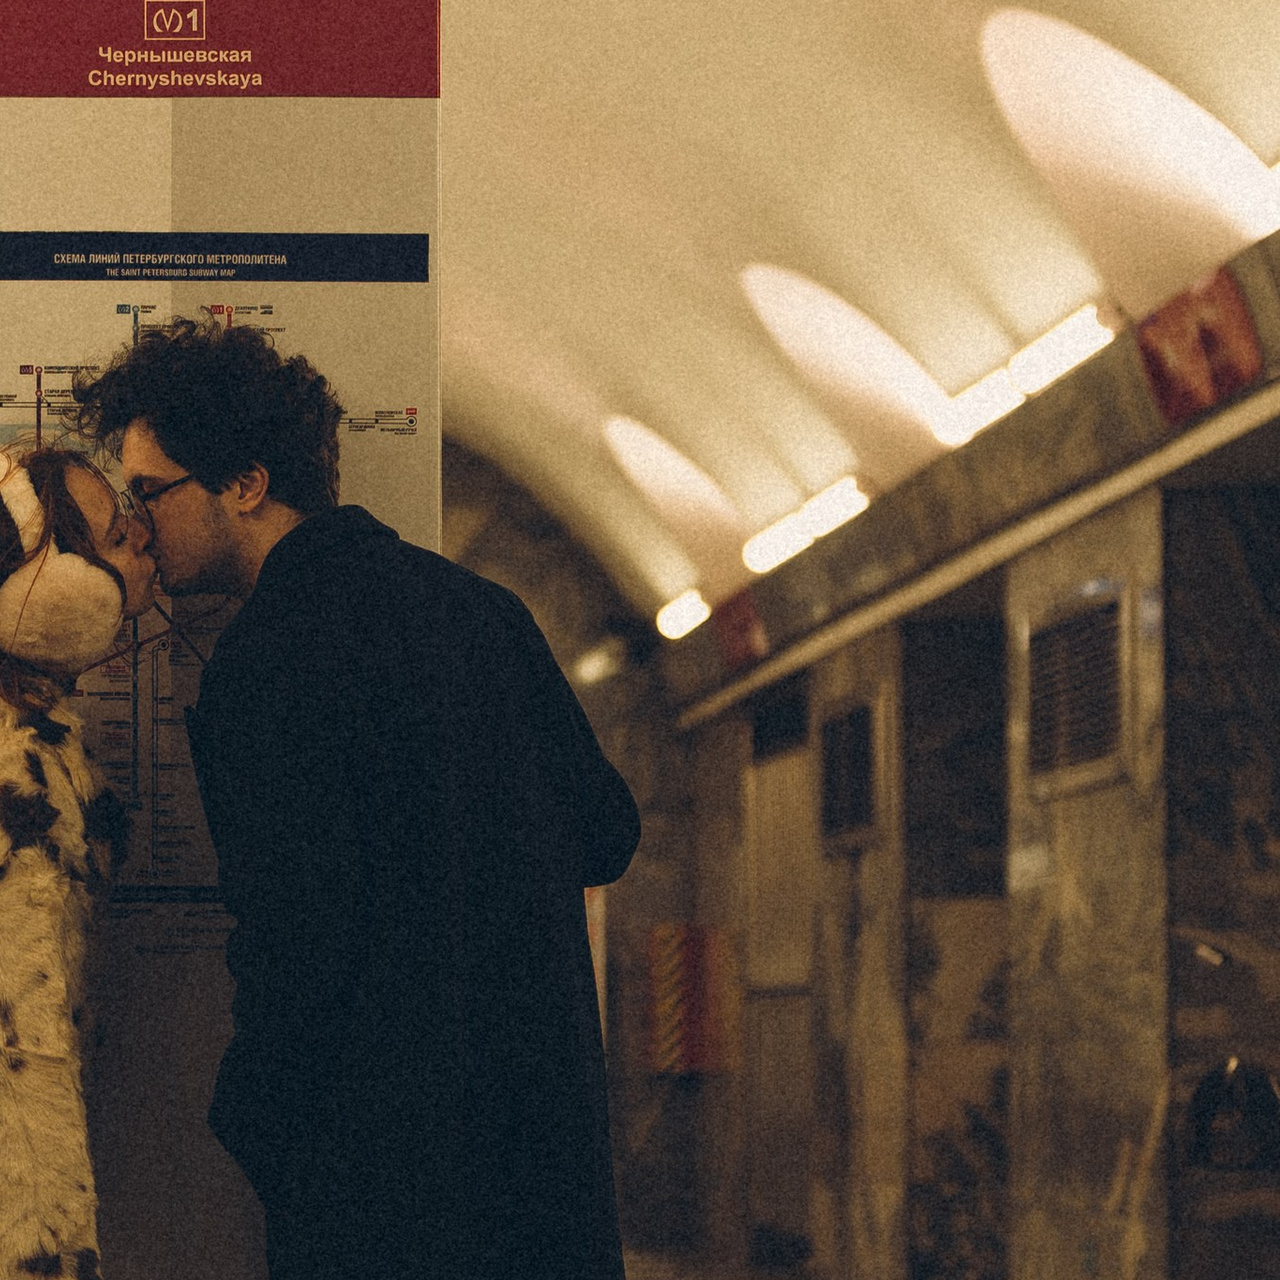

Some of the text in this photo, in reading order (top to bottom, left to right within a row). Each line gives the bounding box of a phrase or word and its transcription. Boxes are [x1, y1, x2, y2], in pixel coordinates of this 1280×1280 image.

[98, 47, 253, 64] Чернышевская
[88, 68, 263, 91] Chernyshevskaya
[54, 251, 287, 266] СХЕМА ЛИНИЙ ПЕТЕРБУРГСКОГО МЕТРОПОЛИТЕНА
[106, 268, 120, 277] THE
